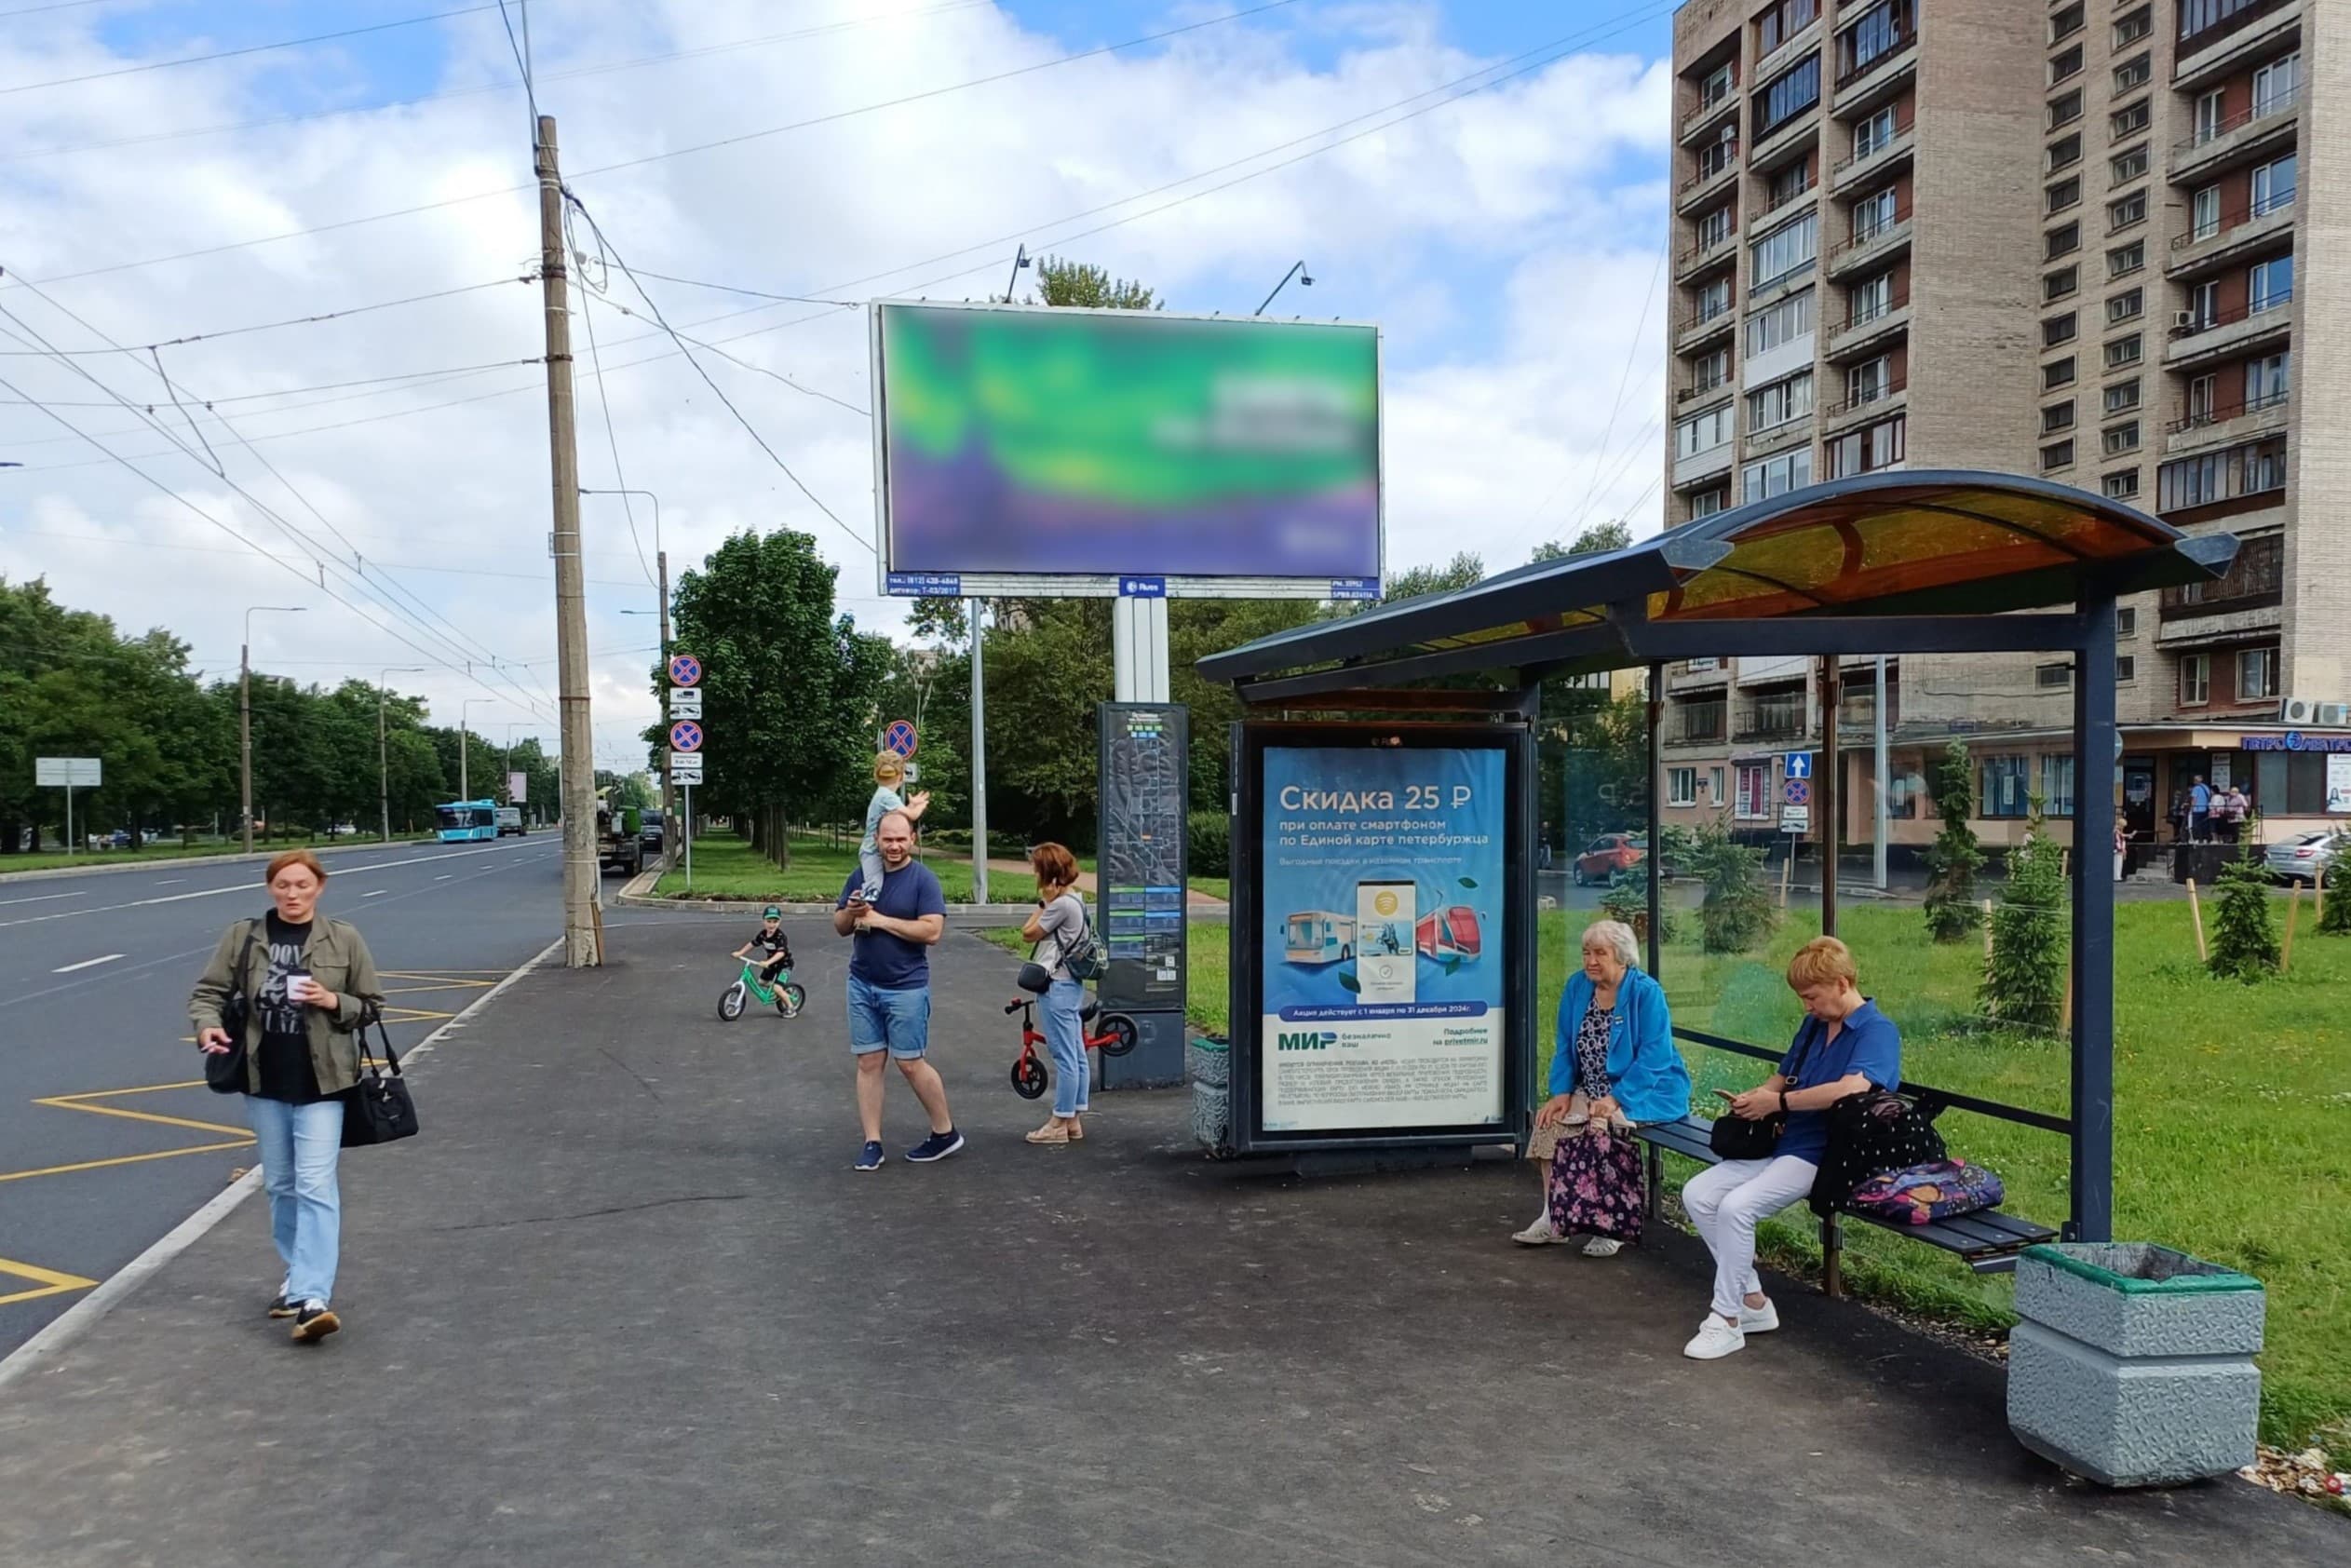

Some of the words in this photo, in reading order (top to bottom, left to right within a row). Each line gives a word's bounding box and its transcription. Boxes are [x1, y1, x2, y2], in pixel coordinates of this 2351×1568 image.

[1279, 786, 1394, 814] Скидка
[1404, 786, 1440, 810] 25
[1279, 821, 1304, 833] при
[1309, 820, 1357, 831] оплате
[1360, 819, 1446, 832] смартфоном
[1279, 836, 1296, 845] по
[1301, 834, 1352, 847] Единой
[1356, 835, 1394, 847] карте
[1398, 834, 1489, 847] петербуржца
[1292, 1009, 1317, 1018] Акция
[1318, 1007, 1357, 1017] действует
[1369, 1007, 1395, 1016] января
[1416, 1006, 1447, 1015] декабря
[1278, 1032, 1338, 1050] МИР
